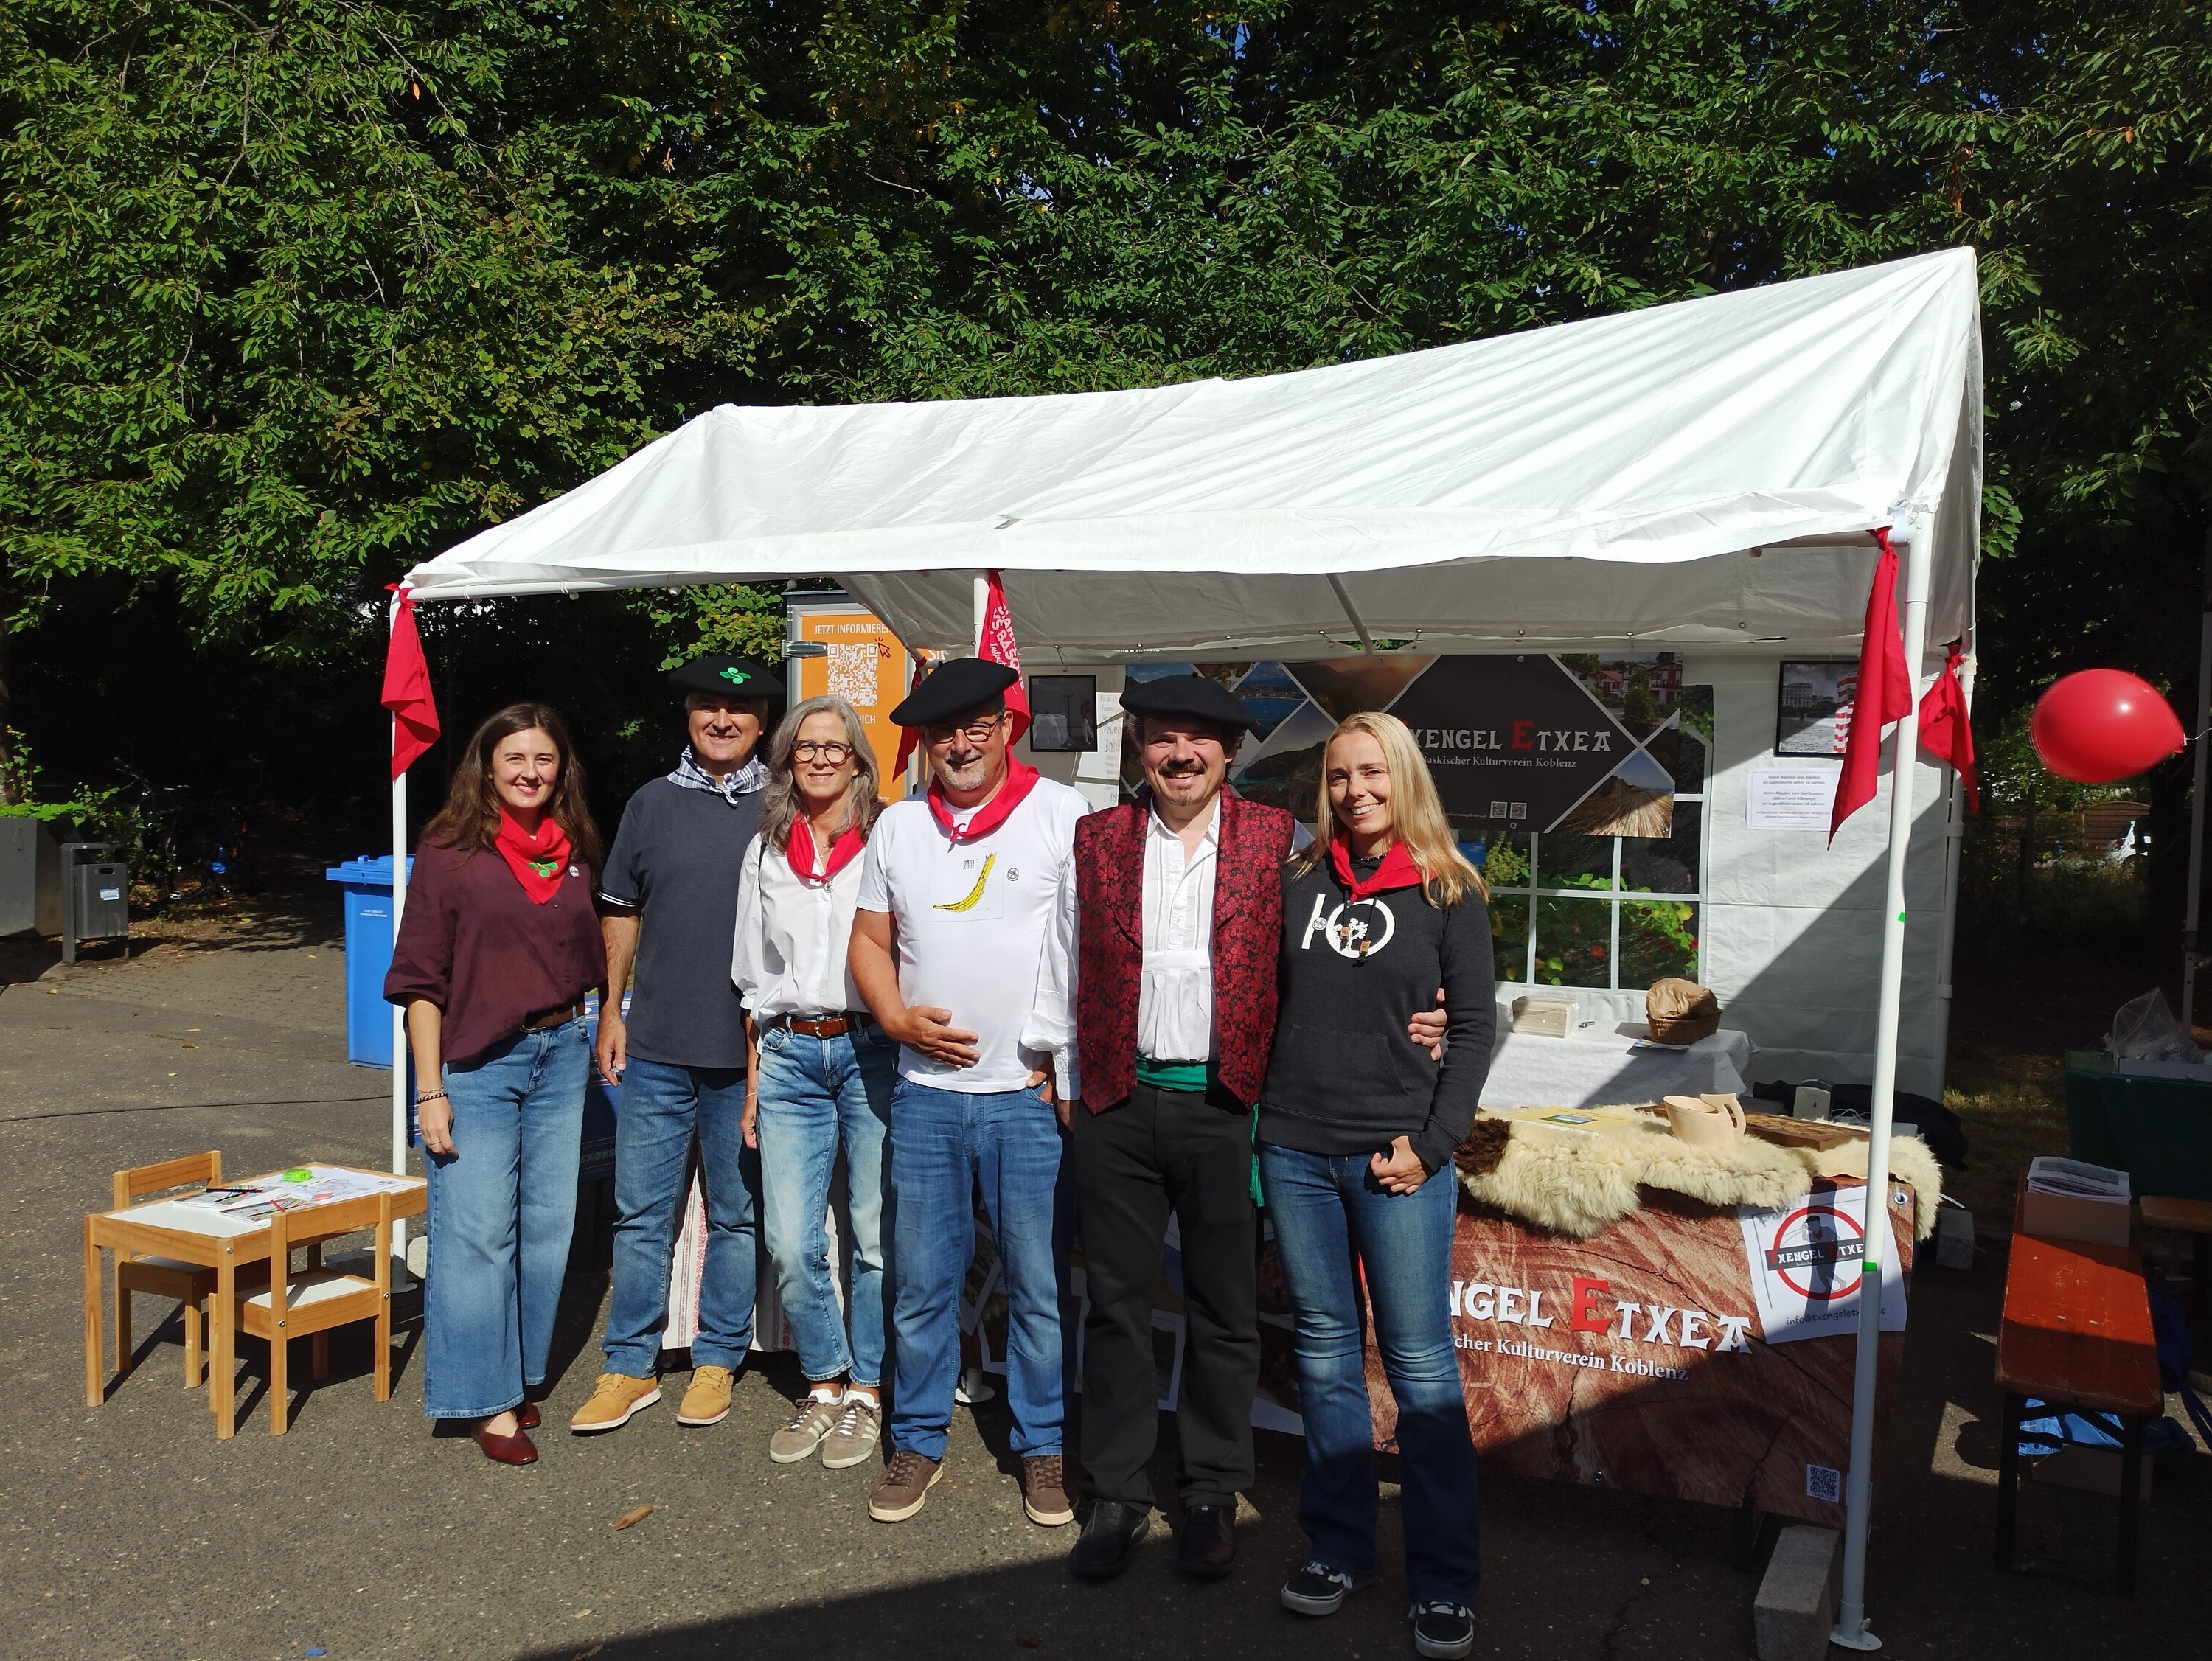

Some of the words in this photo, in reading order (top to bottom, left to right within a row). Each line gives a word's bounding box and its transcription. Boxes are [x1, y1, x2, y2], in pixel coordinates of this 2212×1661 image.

[813, 624, 835, 635] JETZT
[1404, 722, 1503, 750] XENGEL
[1512, 720, 1612, 752] ETXEA
[1472, 756, 1533, 767] Kulturverein
[1535, 758, 1577, 767] Koblenz
[1768, 1249, 1824, 1265] TXENGEL
[1826, 1242, 1864, 1258] ETXE
[1450, 1281, 1554, 1328] NGEL
[1571, 1275, 1753, 1354] ETXEA
[1496, 1338, 1605, 1370] Kulturverein
[1610, 1354, 1689, 1381] Koblenz
